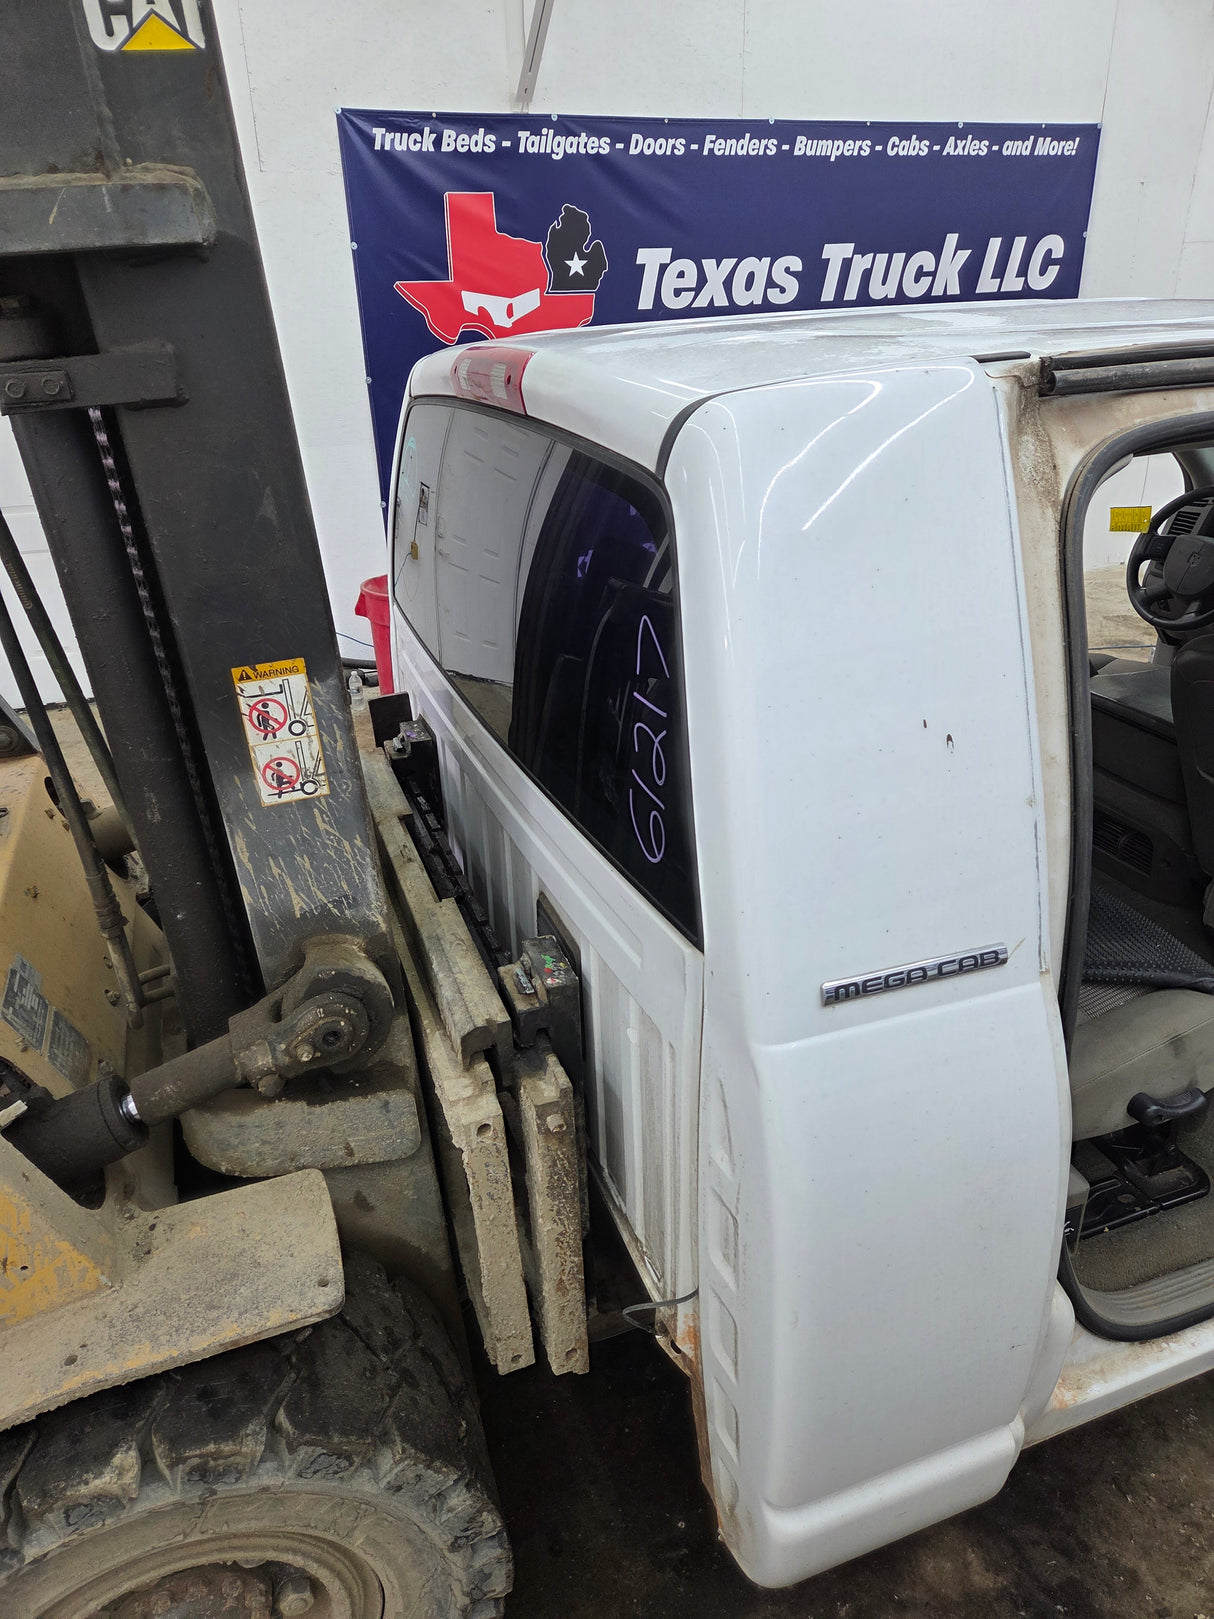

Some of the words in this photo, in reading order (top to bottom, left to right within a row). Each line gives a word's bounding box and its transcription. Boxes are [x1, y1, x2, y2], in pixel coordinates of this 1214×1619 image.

[372, 127, 436, 152] Truck
[441, 128, 496, 153] Beds
[517, 128, 611, 161] Tailgates
[628, 133, 686, 156] Doors
[702, 133, 777, 156] Fenders
[793, 135, 871, 162] Bumpers
[886, 135, 930, 157] Cabs
[942, 135, 990, 157] Axles
[1001, 136, 1032, 156] and
[1034, 136, 1080, 156] More!
[636, 247, 803, 310] Texas
[820, 233, 973, 302] Truck
[975, 234, 1065, 294] LLC
[252, 665, 300, 679] WARNING
[629, 615, 670, 864] 61217
[833, 966, 928, 1001] MEGA
[936, 949, 1001, 977] CAB
